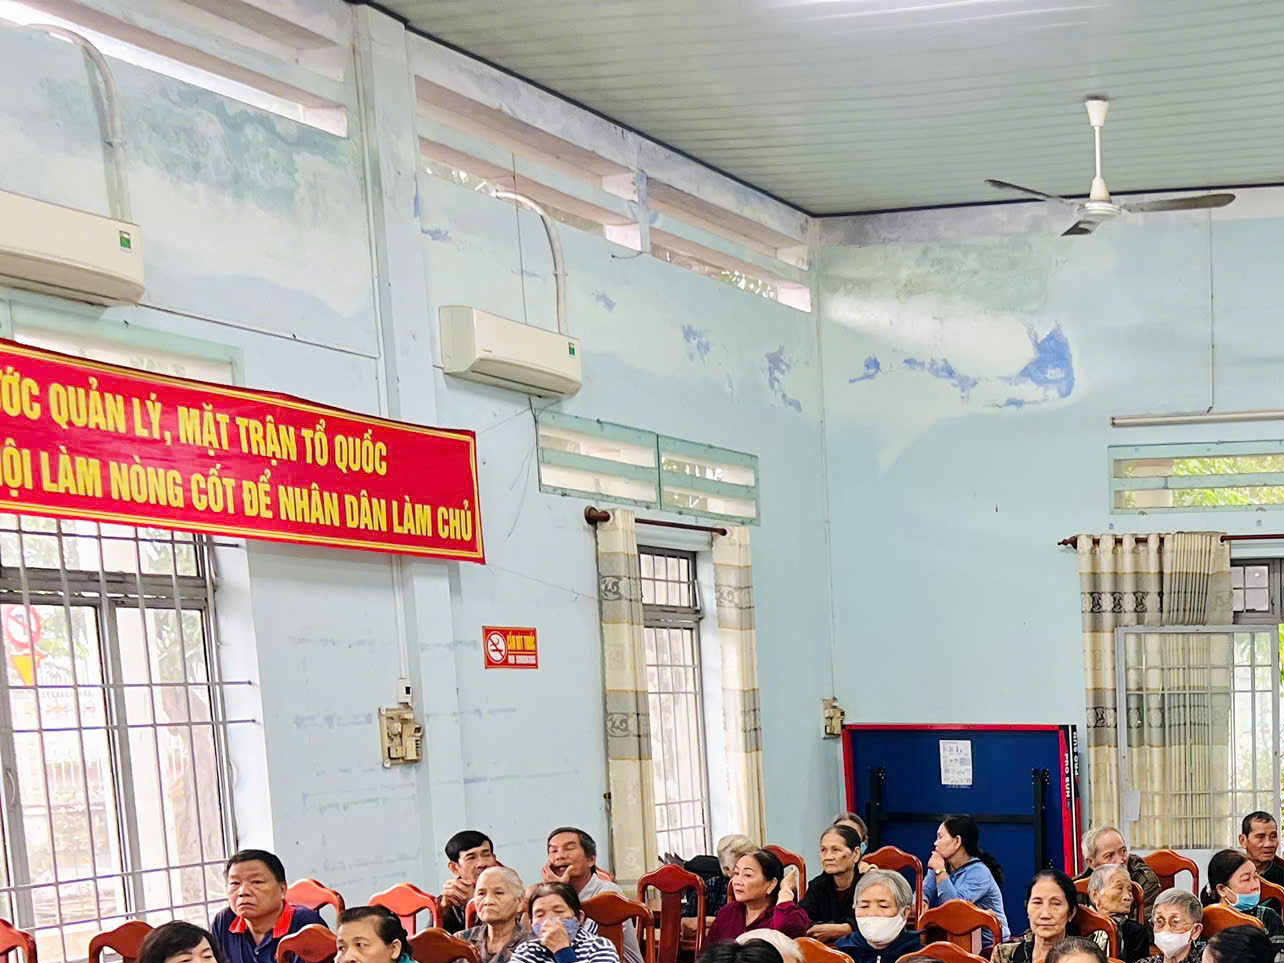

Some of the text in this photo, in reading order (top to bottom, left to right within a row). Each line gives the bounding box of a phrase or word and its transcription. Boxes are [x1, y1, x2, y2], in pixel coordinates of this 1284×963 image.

[0, 366, 388, 476] ỚC QUẢN LÝ, MẶT TRẬN TỔ QUỐC
[0, 437, 472, 541] ỘI LÀM NÒNG CỐT ĐỂ NHÂN DÂN LÀM CHỦ
